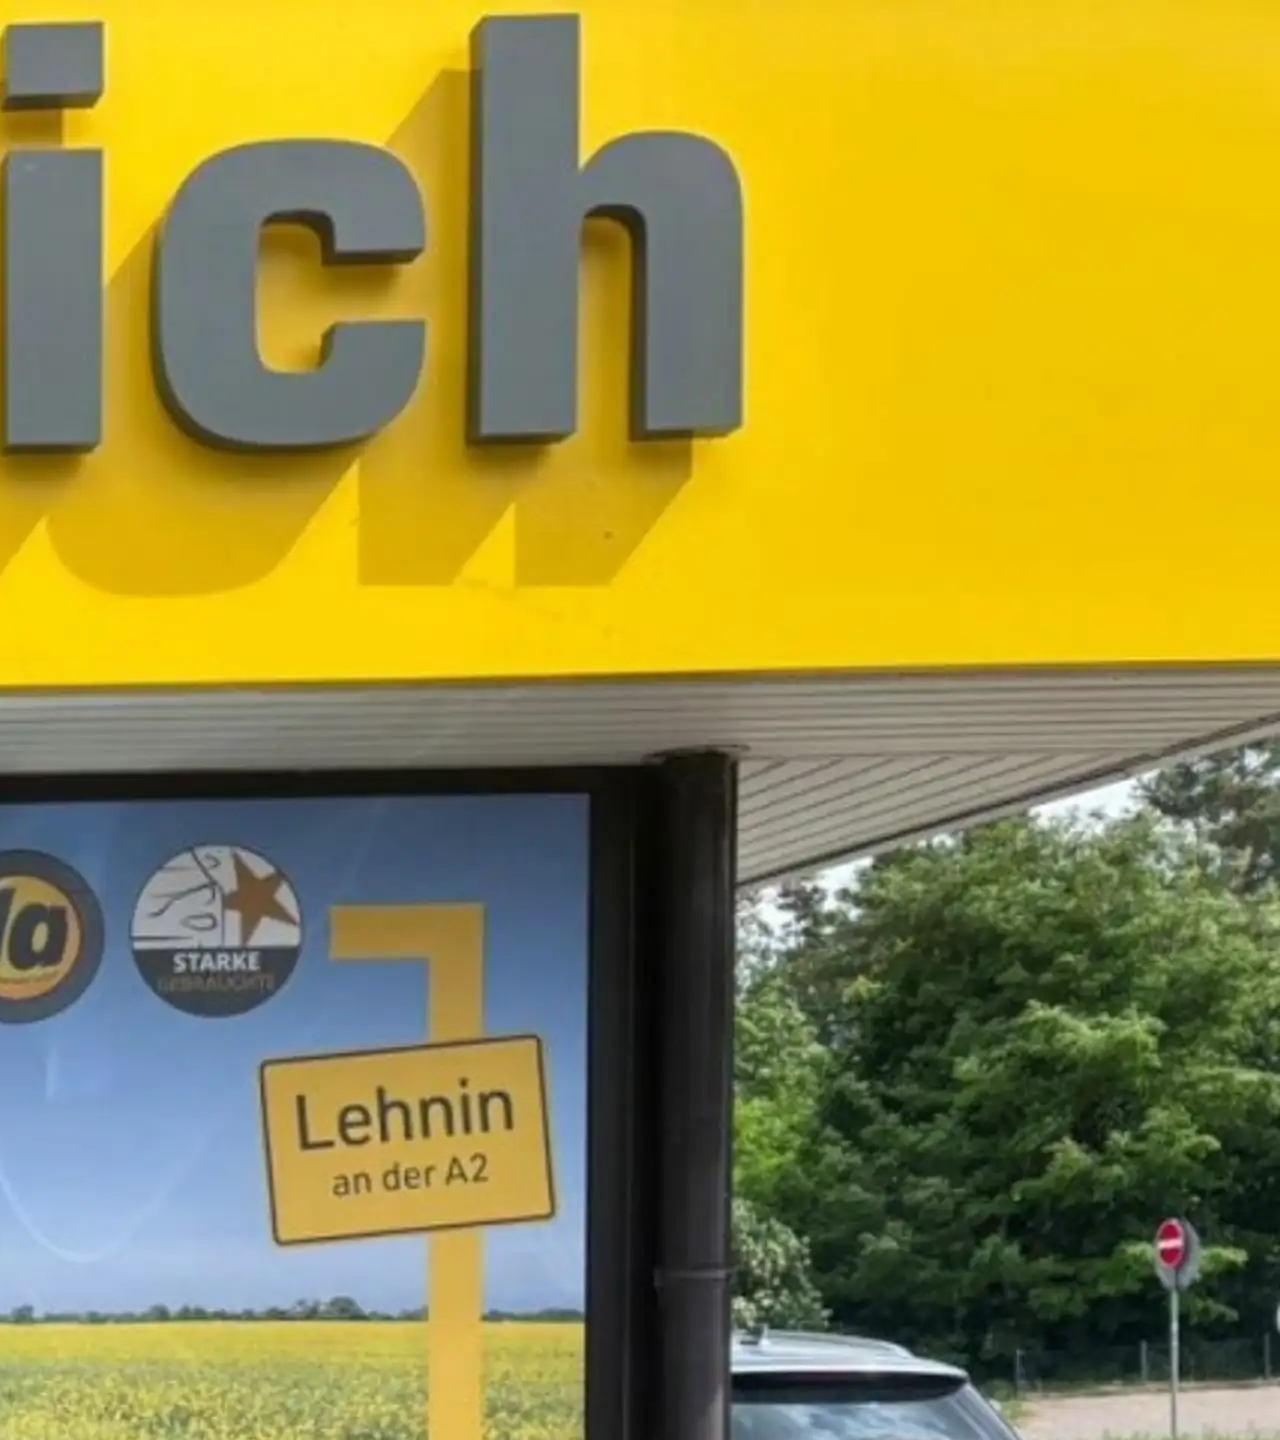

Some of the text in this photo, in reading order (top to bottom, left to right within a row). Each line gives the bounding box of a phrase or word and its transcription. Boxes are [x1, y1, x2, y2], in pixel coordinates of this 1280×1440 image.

[173, 950, 262, 974] STARKE
[295, 1076, 515, 1151] Lehnin
[332, 1152, 490, 1197] an der A2
